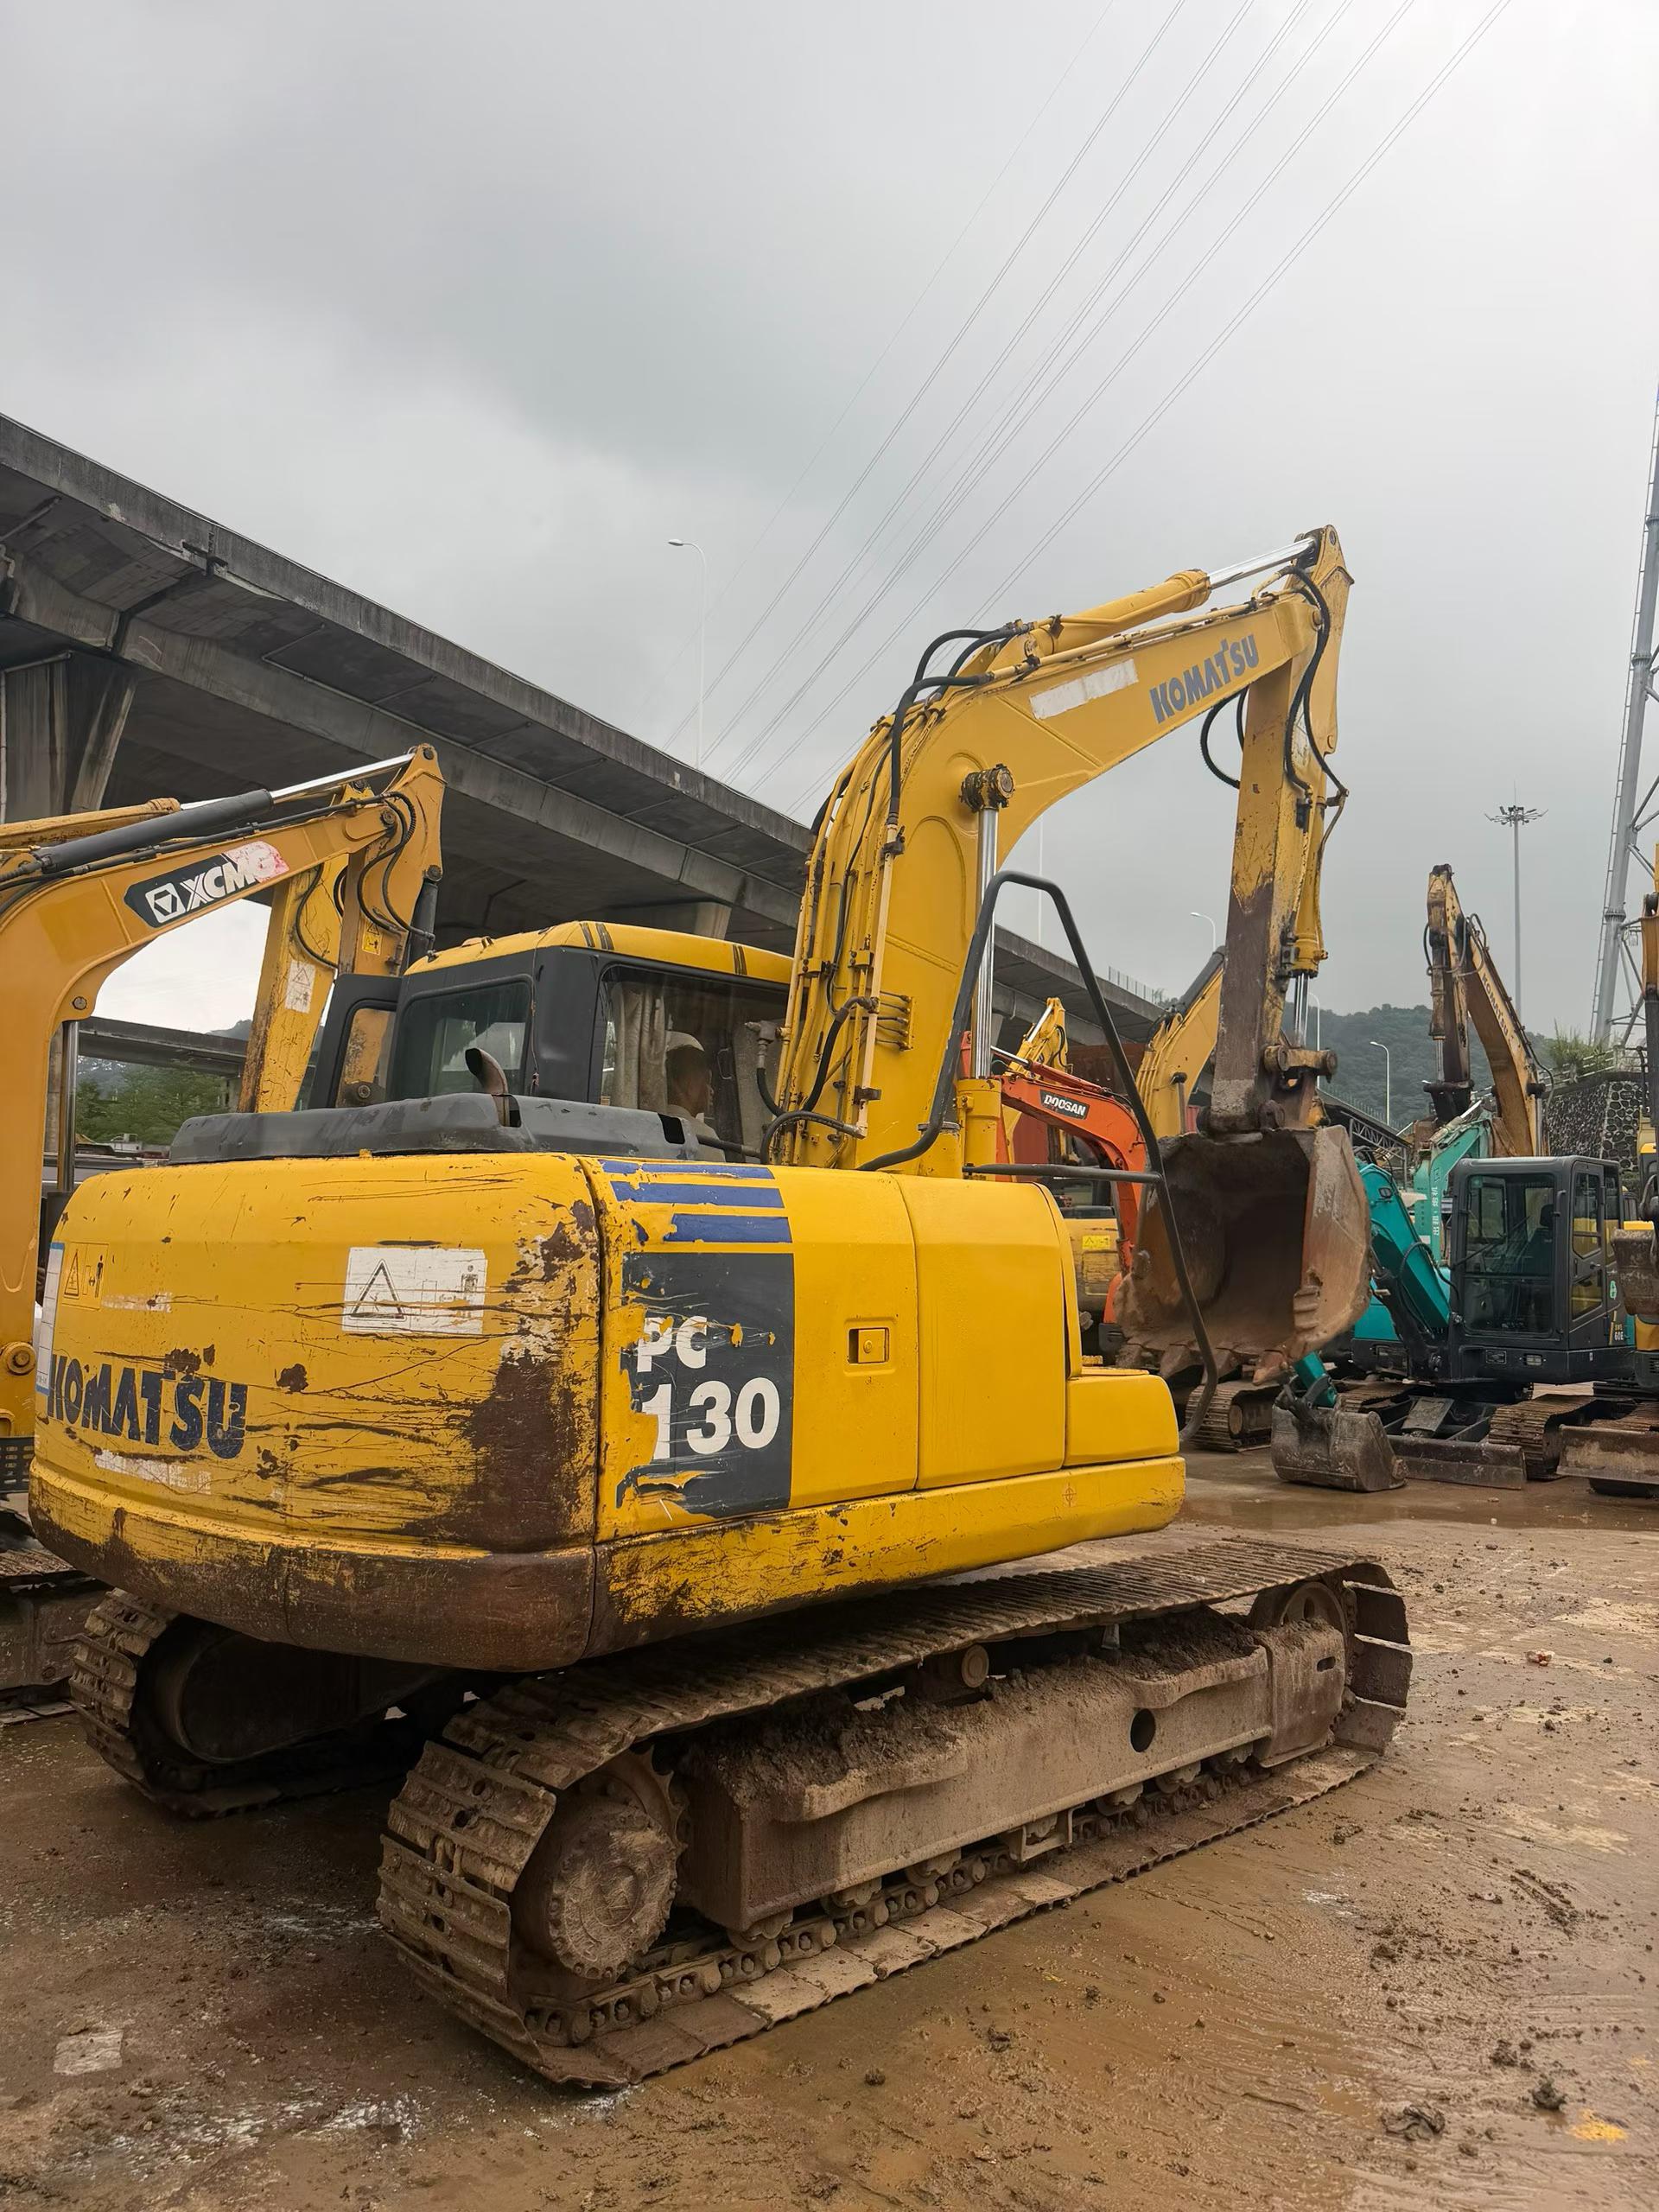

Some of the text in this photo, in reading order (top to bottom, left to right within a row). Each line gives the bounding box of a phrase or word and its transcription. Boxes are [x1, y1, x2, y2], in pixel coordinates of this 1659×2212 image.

[1149, 633, 1259, 724] KOMATSU
[1482, 972, 1509, 1037] KOMATSU
[1043, 1093, 1086, 1116] DOOSAN
[637, 1315, 708, 1372] PC
[48, 1353, 248, 1459] KOMATSU
[642, 1377, 780, 1459] 130
